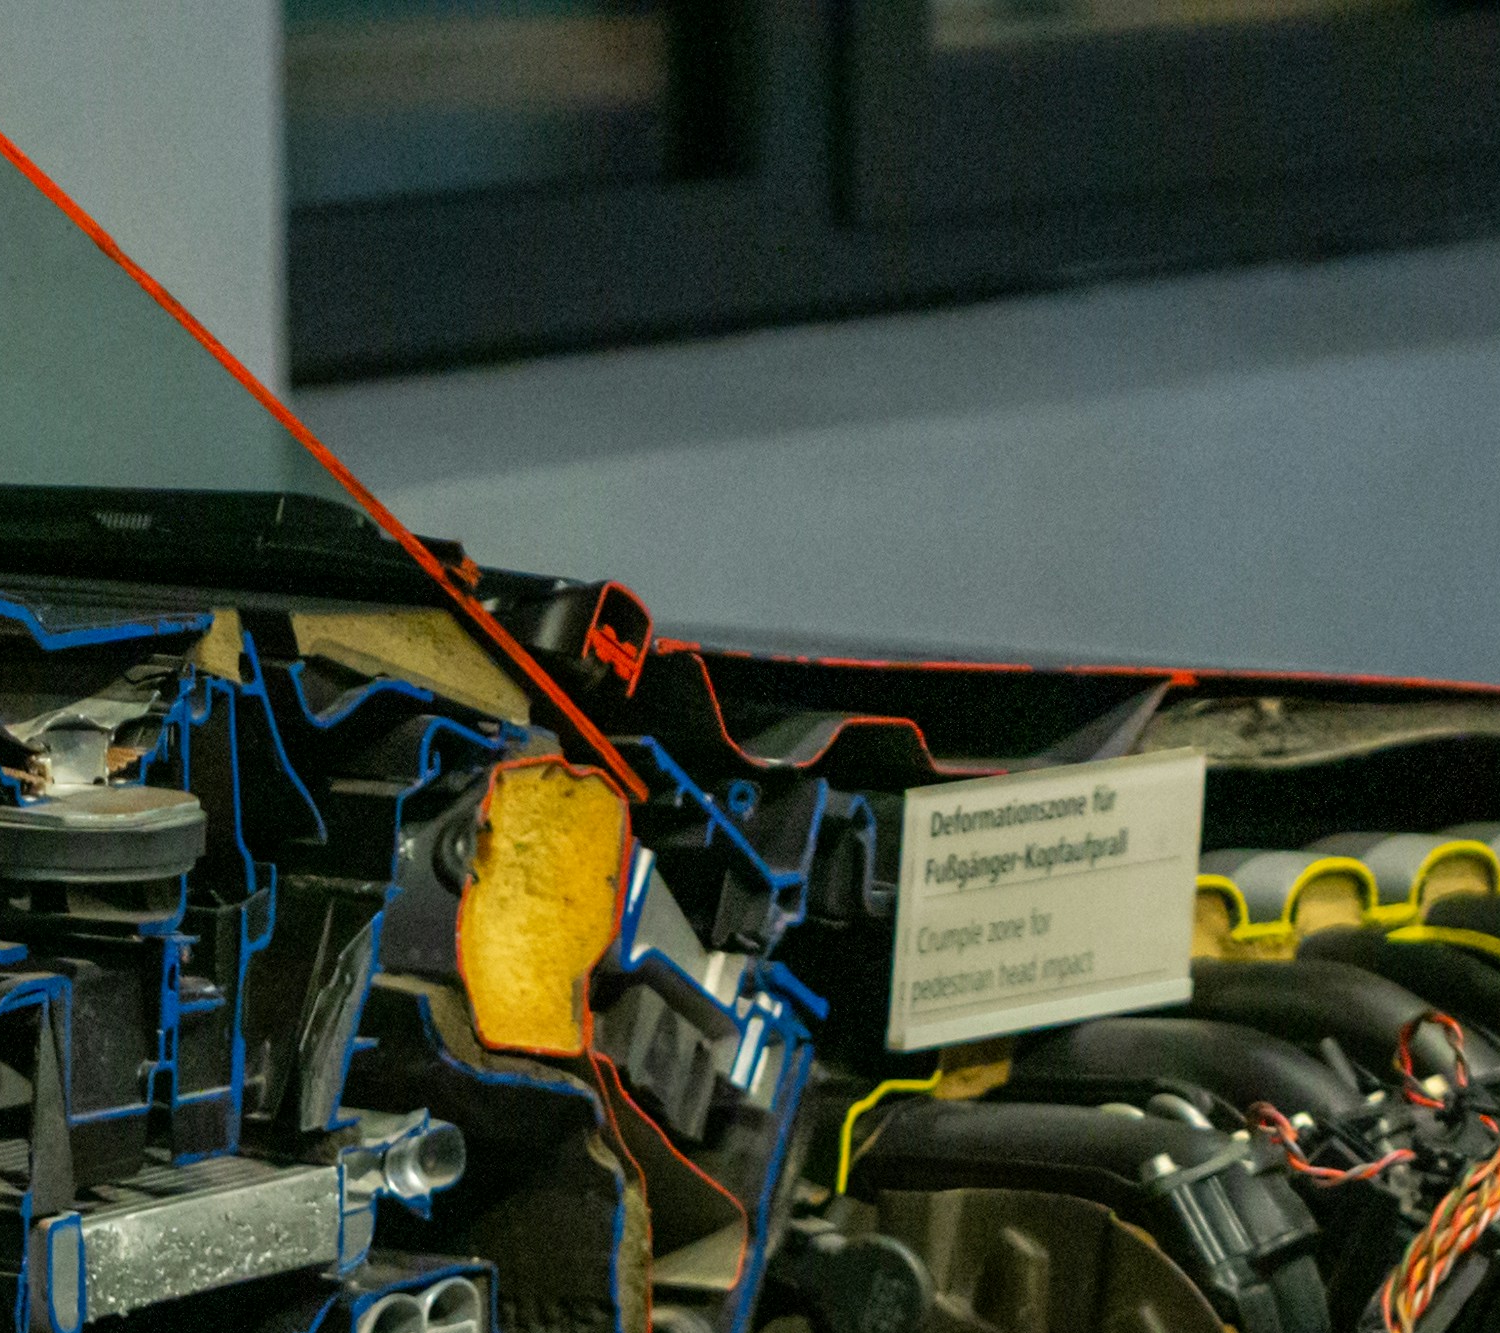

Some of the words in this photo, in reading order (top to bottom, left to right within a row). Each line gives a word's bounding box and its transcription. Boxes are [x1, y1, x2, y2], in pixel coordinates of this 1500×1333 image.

[930, 793, 1088, 838] Deformationszone
[1092, 784, 1117, 813] für
[925, 828, 1128, 887] Fußgänger-Kopfaufprall
[916, 922, 983, 954] Crumple
[987, 918, 1025, 943] zone
[1031, 908, 1052, 936] for
[911, 967, 994, 1003] pedestrian
[999, 959, 1038, 986] head
[1041, 950, 1096, 981] impact
